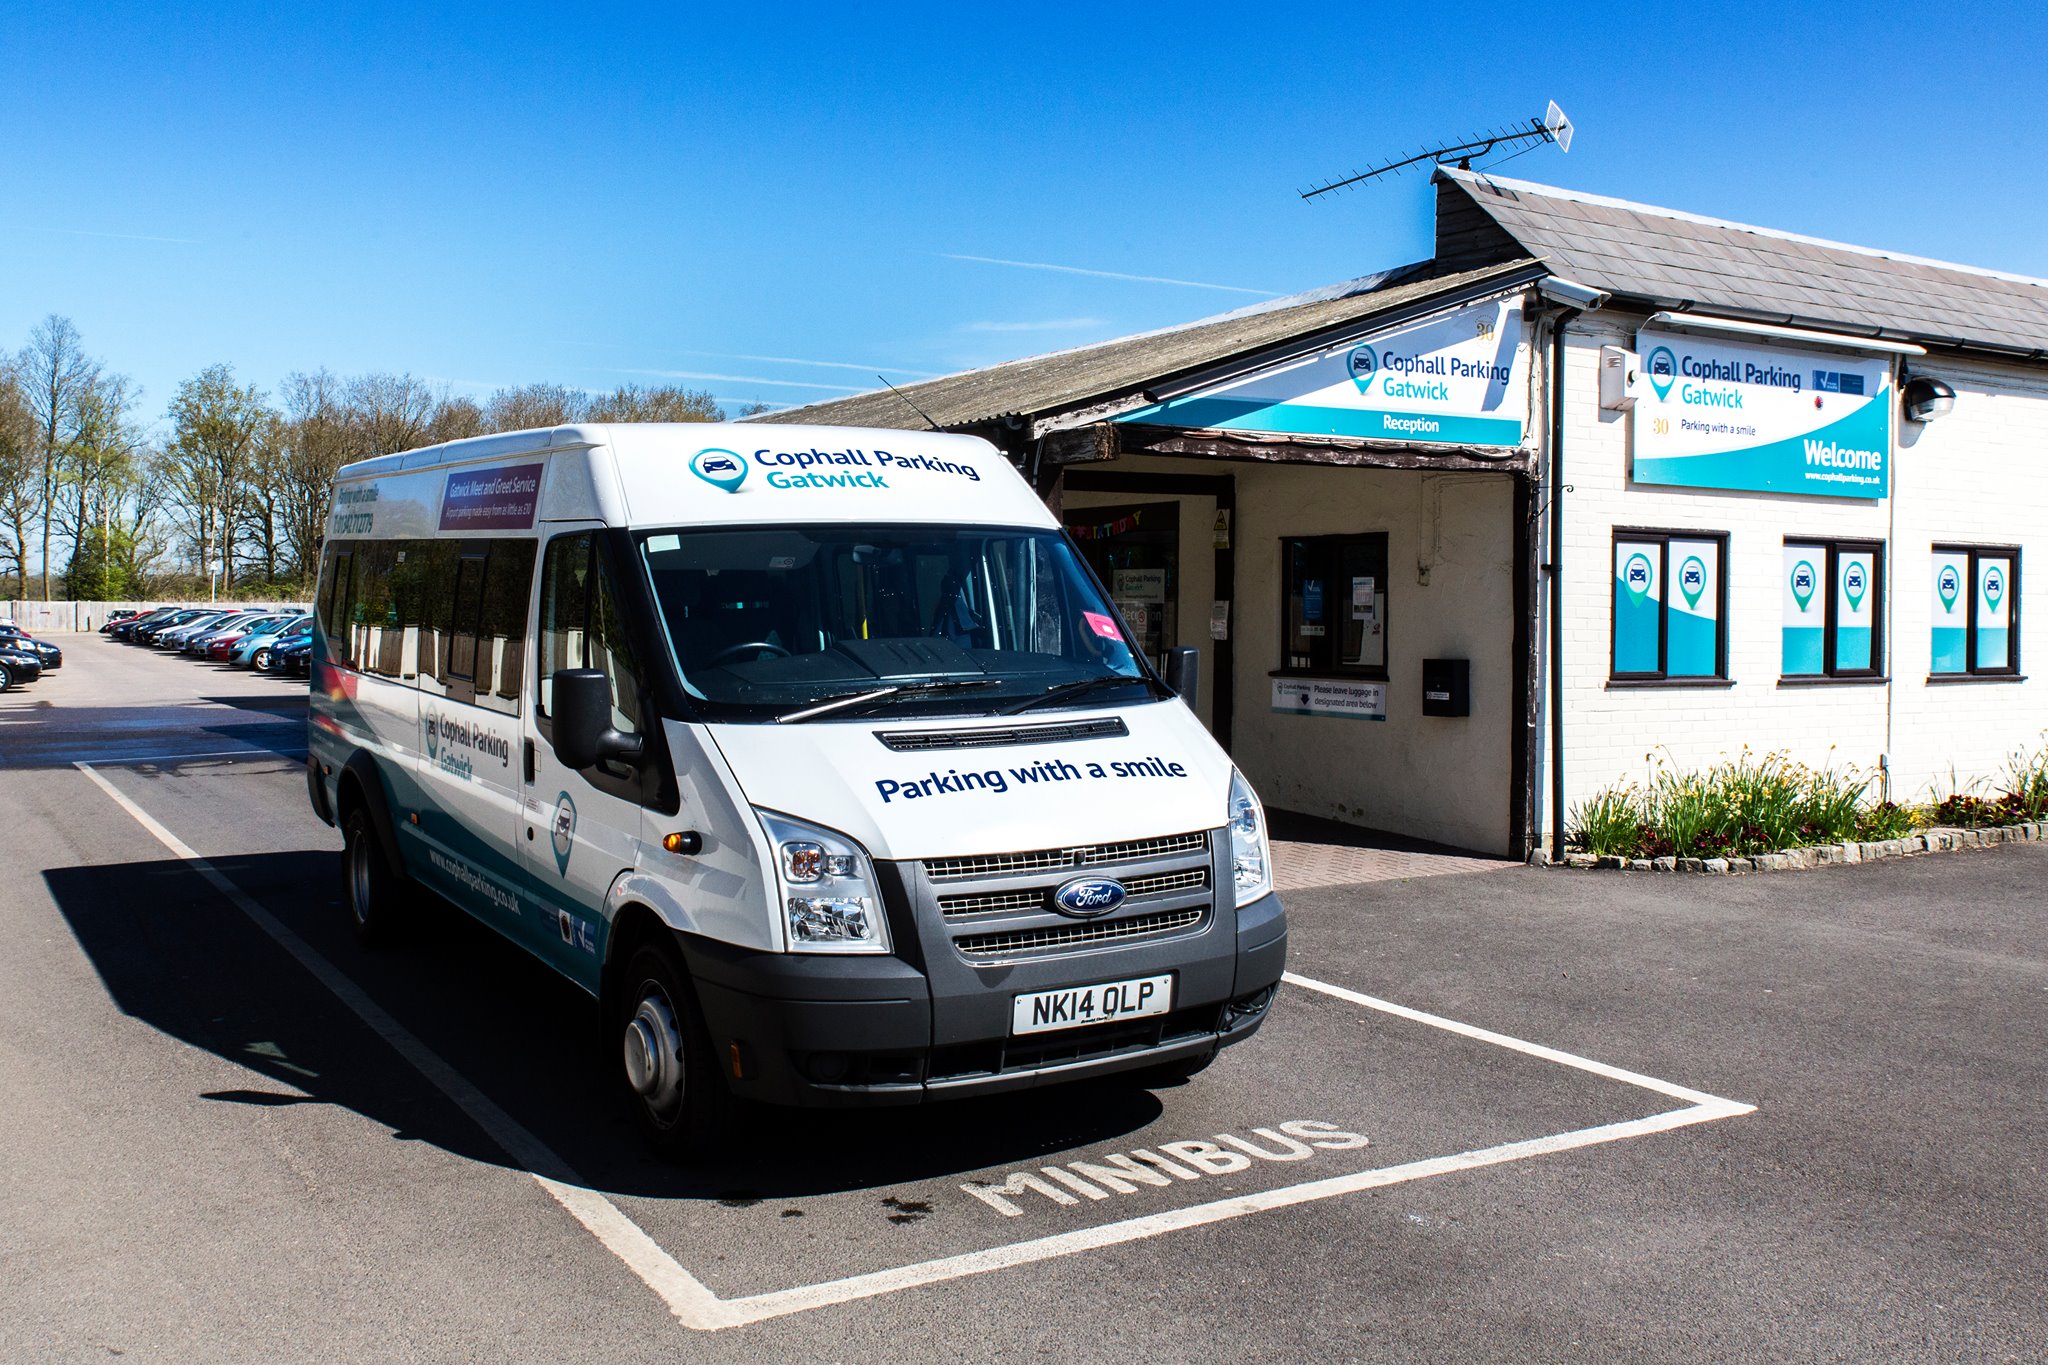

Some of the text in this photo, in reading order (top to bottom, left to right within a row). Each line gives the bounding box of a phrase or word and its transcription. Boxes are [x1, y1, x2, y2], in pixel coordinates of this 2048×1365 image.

[1476, 322, 1495, 342] 30
[1382, 351, 1510, 386] Cophall Parking
[1681, 355, 1801, 393] Cophall Parking
[1383, 377, 1449, 401] Gatwick
[1681, 383, 1743, 409] Gatwick
[1383, 414, 1440, 434] Reception
[1653, 418, 1669, 435] 30
[1681, 419, 1756, 436] Parking with a smile
[754, 448, 981, 482] Cophall Parking
[1803, 438, 1882, 470] Welcome
[471, 481, 485, 497] Meet
[483, 477, 496, 495] and
[495, 477, 513, 495] Greet
[512, 475, 537, 494] Service
[766, 470, 890, 489] Gatwick
[1805, 471, 1881, 486] www.cophallparking.co.uk
[1313, 685, 1379, 698] Please leave luggage in
[1314, 697, 1378, 709] designated area below
[440, 713, 509, 768] Cophall Parking
[440, 746, 473, 783] Gatwick
[874, 757, 1188, 803] Parking with a smile
[429, 848, 522, 916] www.cophallparking.co.uk
[1075, 885, 1113, 907] Ford
[1031, 982, 1155, 1026] NK14 OLP
[959, 1119, 1370, 1218] MINIBUS
